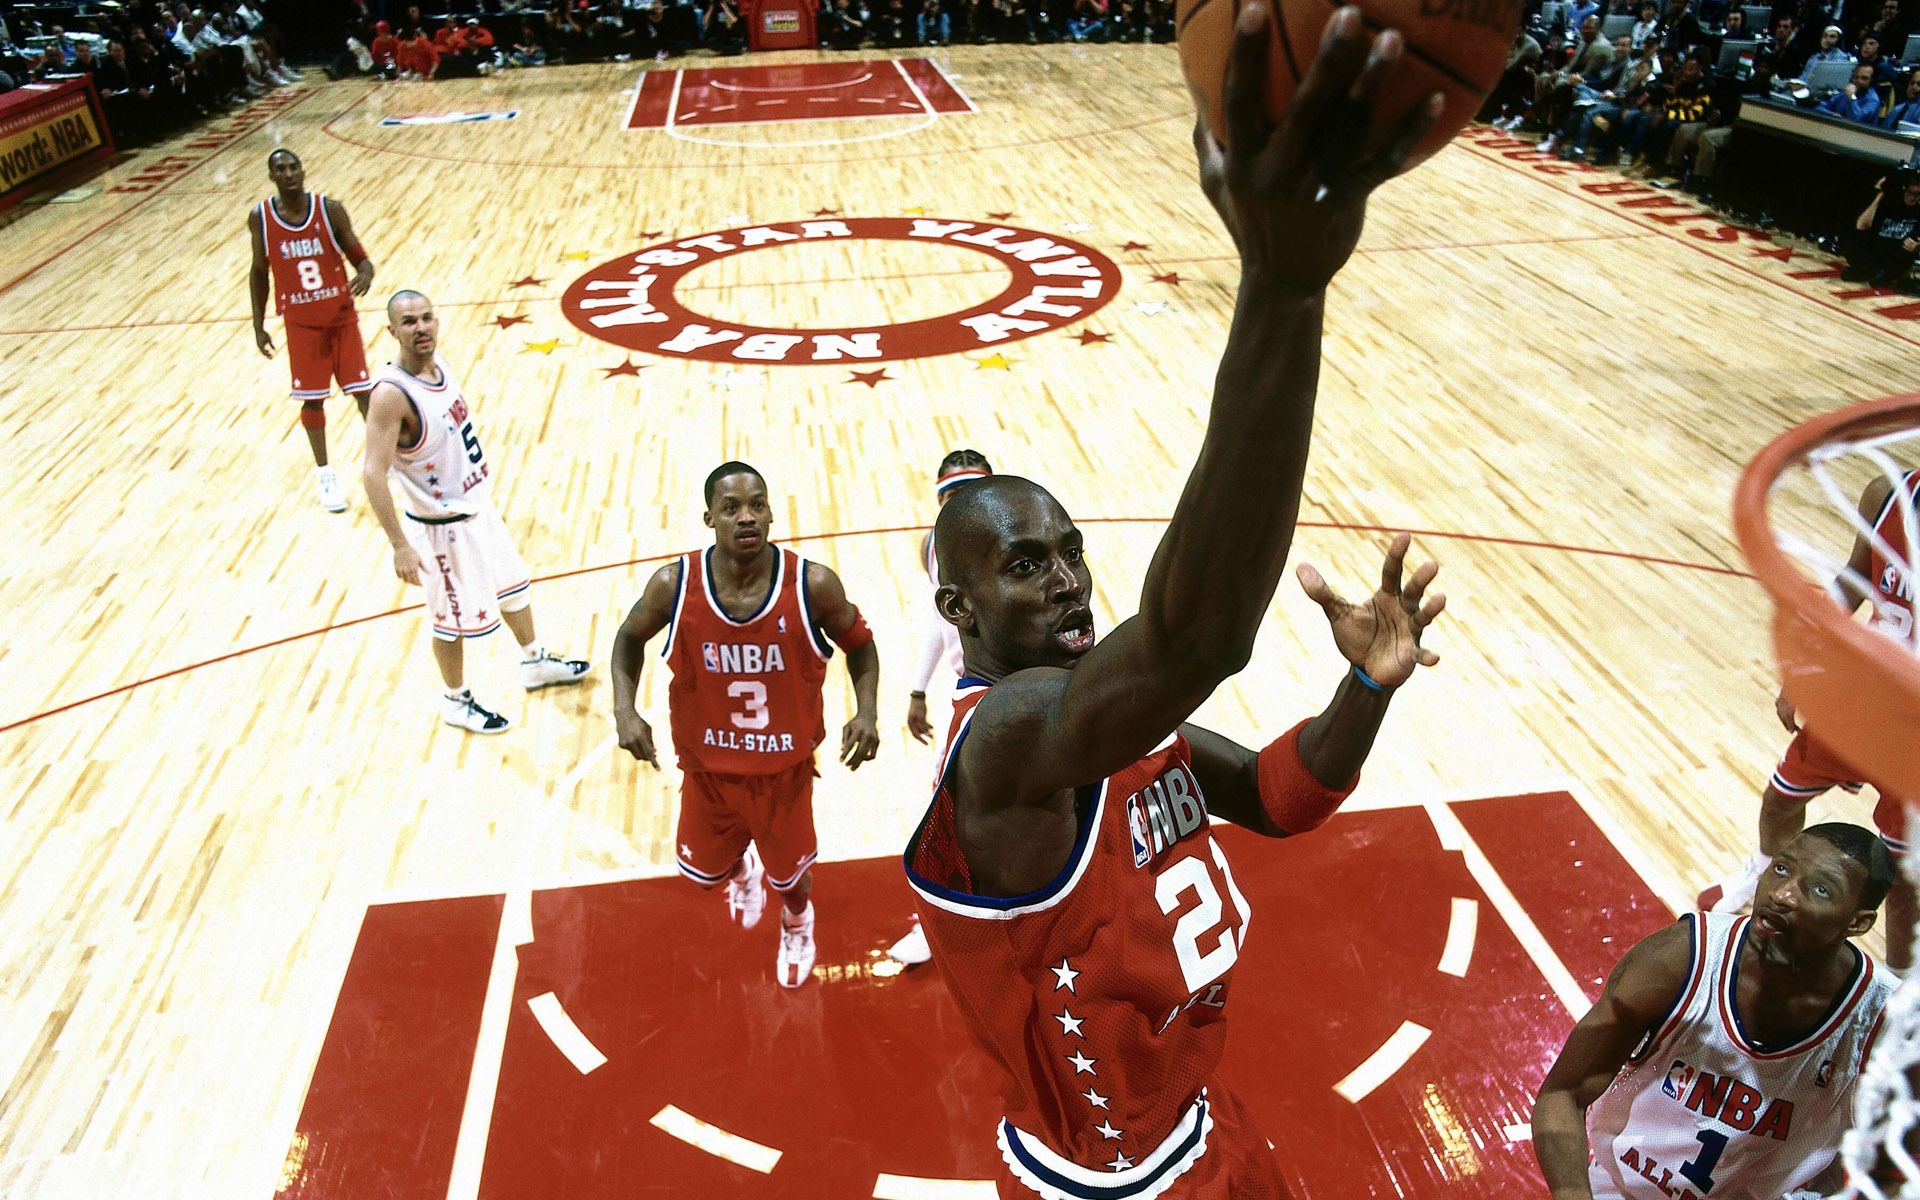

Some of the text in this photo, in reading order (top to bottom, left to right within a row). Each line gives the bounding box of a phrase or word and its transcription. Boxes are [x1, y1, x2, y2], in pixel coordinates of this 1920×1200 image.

[48, 113, 93, 158] NBA
[105, 156, 203, 193] EAST
[290, 237, 324, 258] NBA
[297, 259, 324, 291] 8
[579, 219, 1103, 343] ALL-STAR ATLANTA
[658, 324, 883, 361] NBA
[461, 421, 483, 464] 5
[436, 554, 462, 628] EAST
[719, 643, 786, 674] NBA
[727, 680, 770, 730] 3
[703, 728, 795, 753] ALL-STAR
[1684, 1070, 1795, 1142] NBA
[1679, 1128, 1729, 1195] 1
